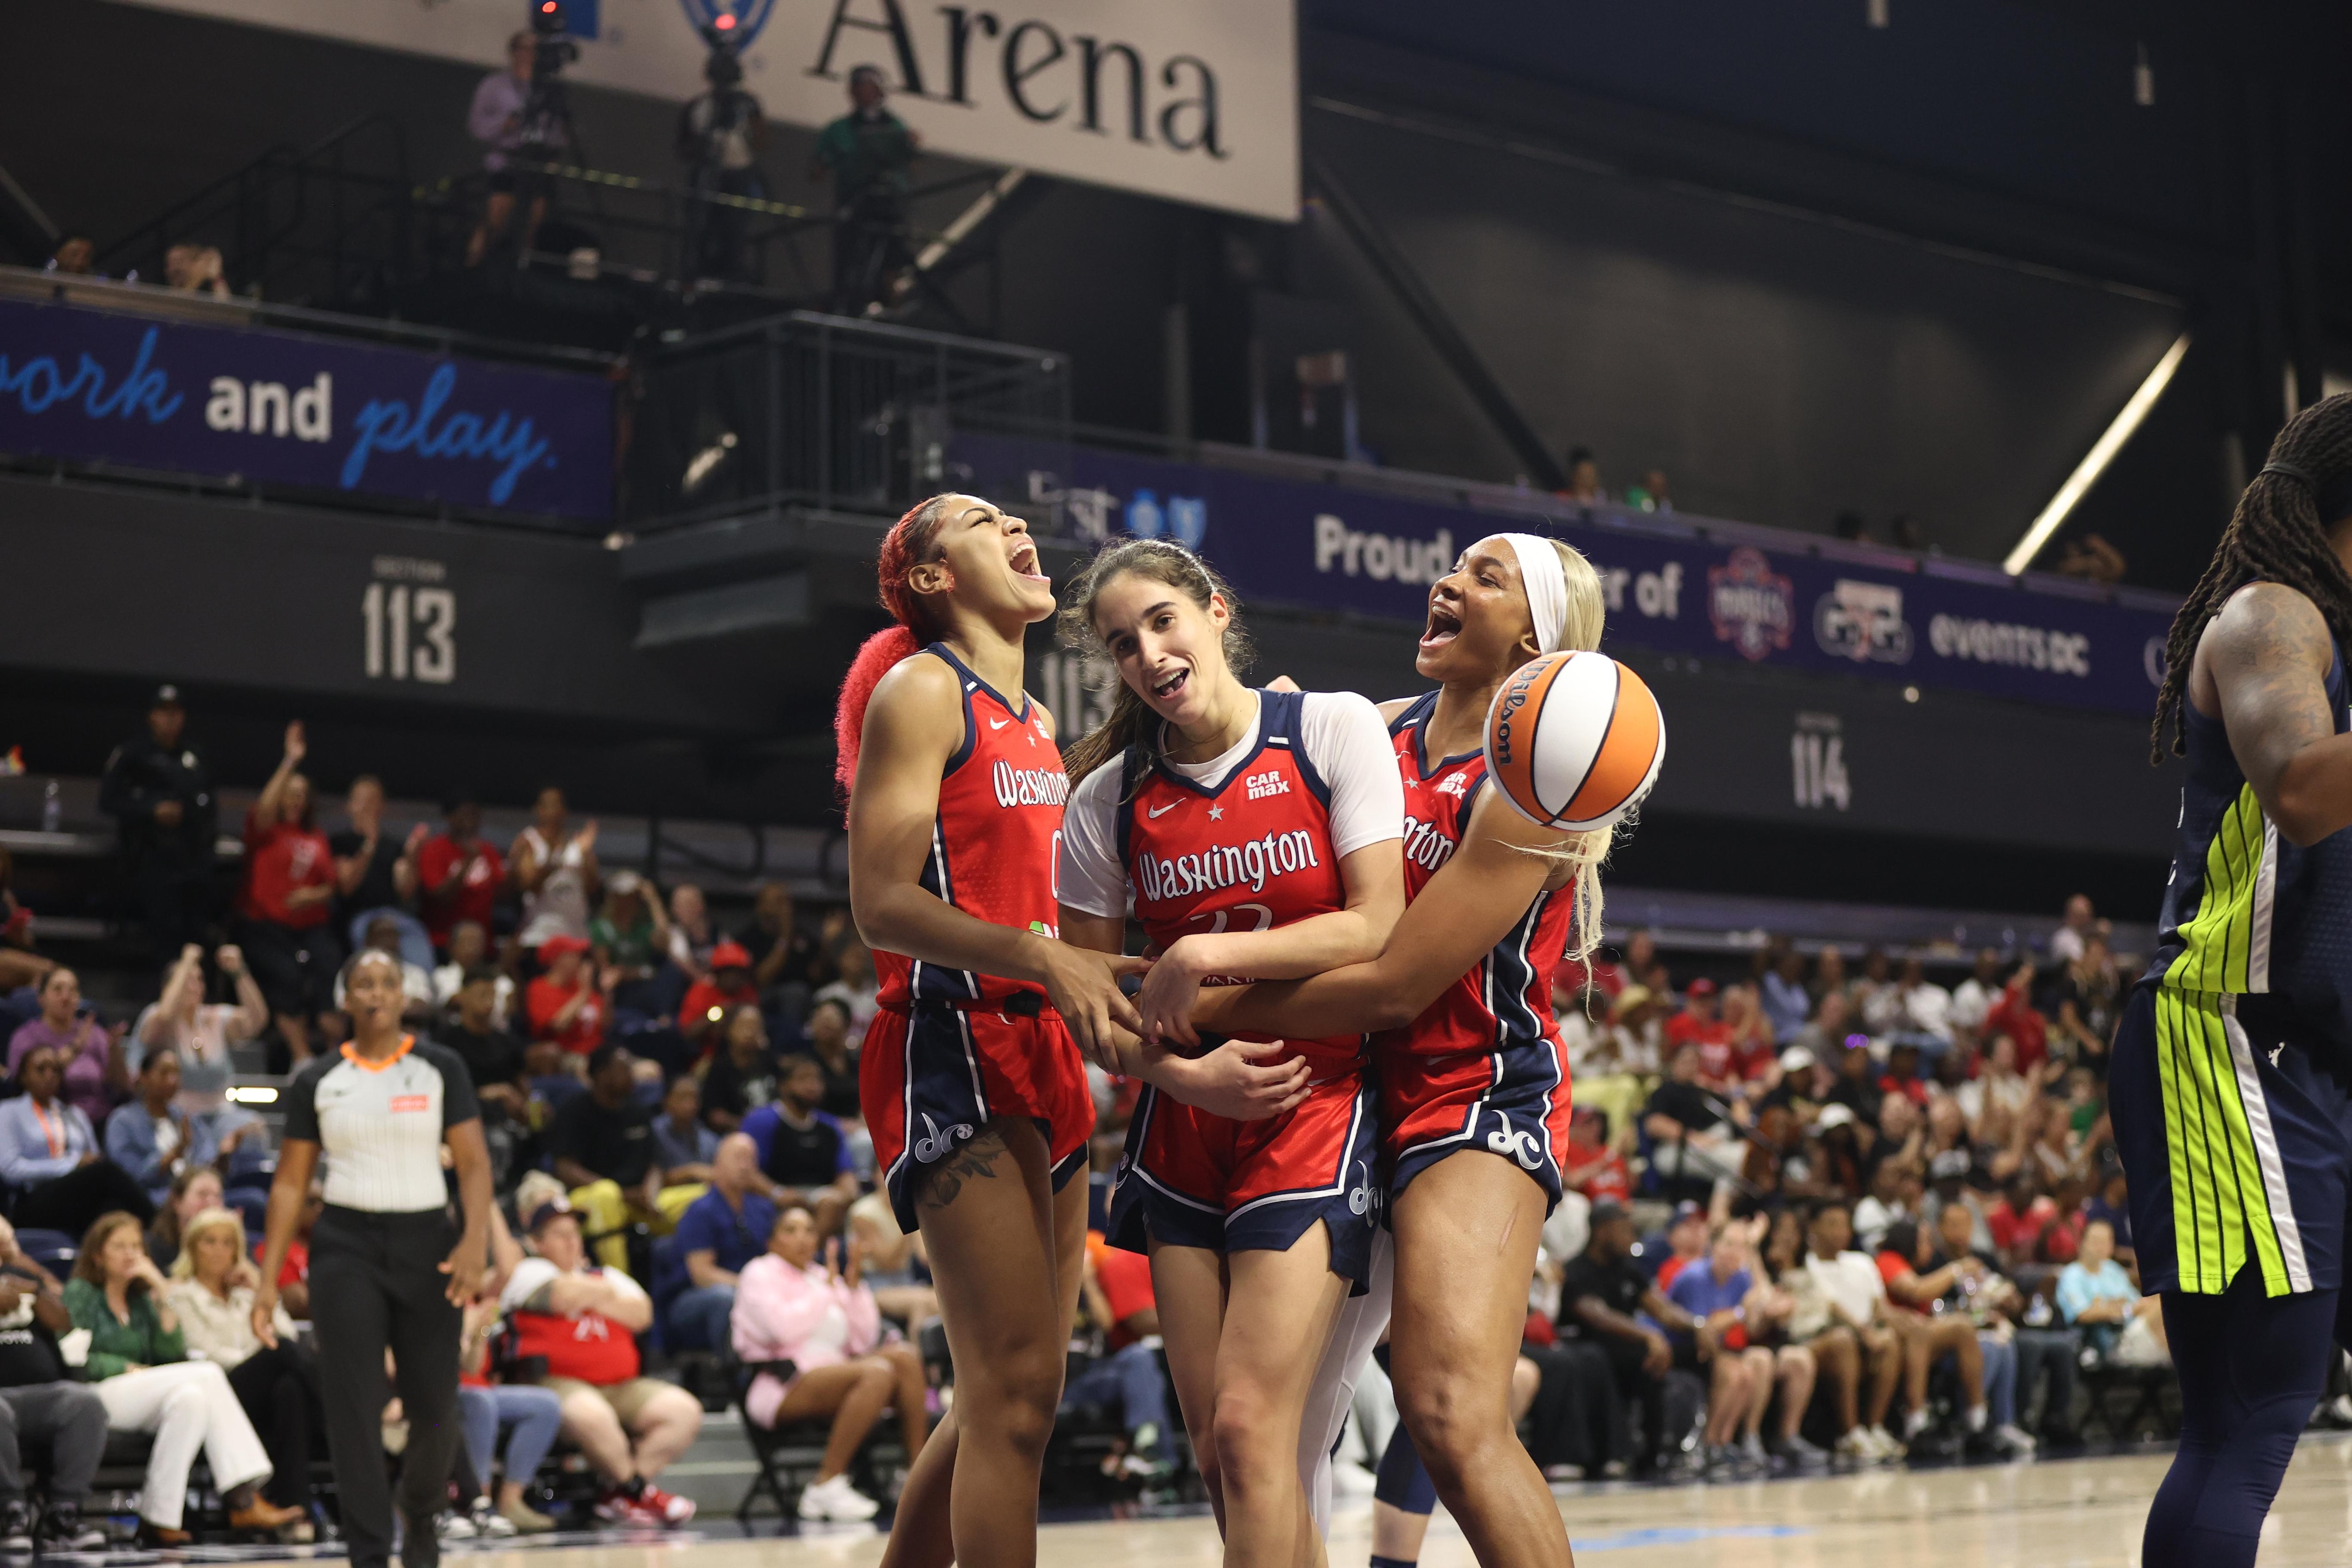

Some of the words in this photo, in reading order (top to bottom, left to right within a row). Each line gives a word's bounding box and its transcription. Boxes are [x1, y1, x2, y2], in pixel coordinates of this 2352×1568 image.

[803, 0, 1233, 162] Arena
[205, 371, 333, 443] and
[340, 361, 558, 506] play.
[1314, 513, 1454, 587] Proud
[1635, 560, 1684, 620] of
[361, 583, 457, 684] 113
[1497, 659, 1555, 768] Wilson
[1246, 770, 1280, 788] CAR
[1248, 780, 1290, 800] max
[1436, 782, 1467, 800] max
[1791, 732, 1852, 812] 114
[1139, 829, 1318, 902] Washington
